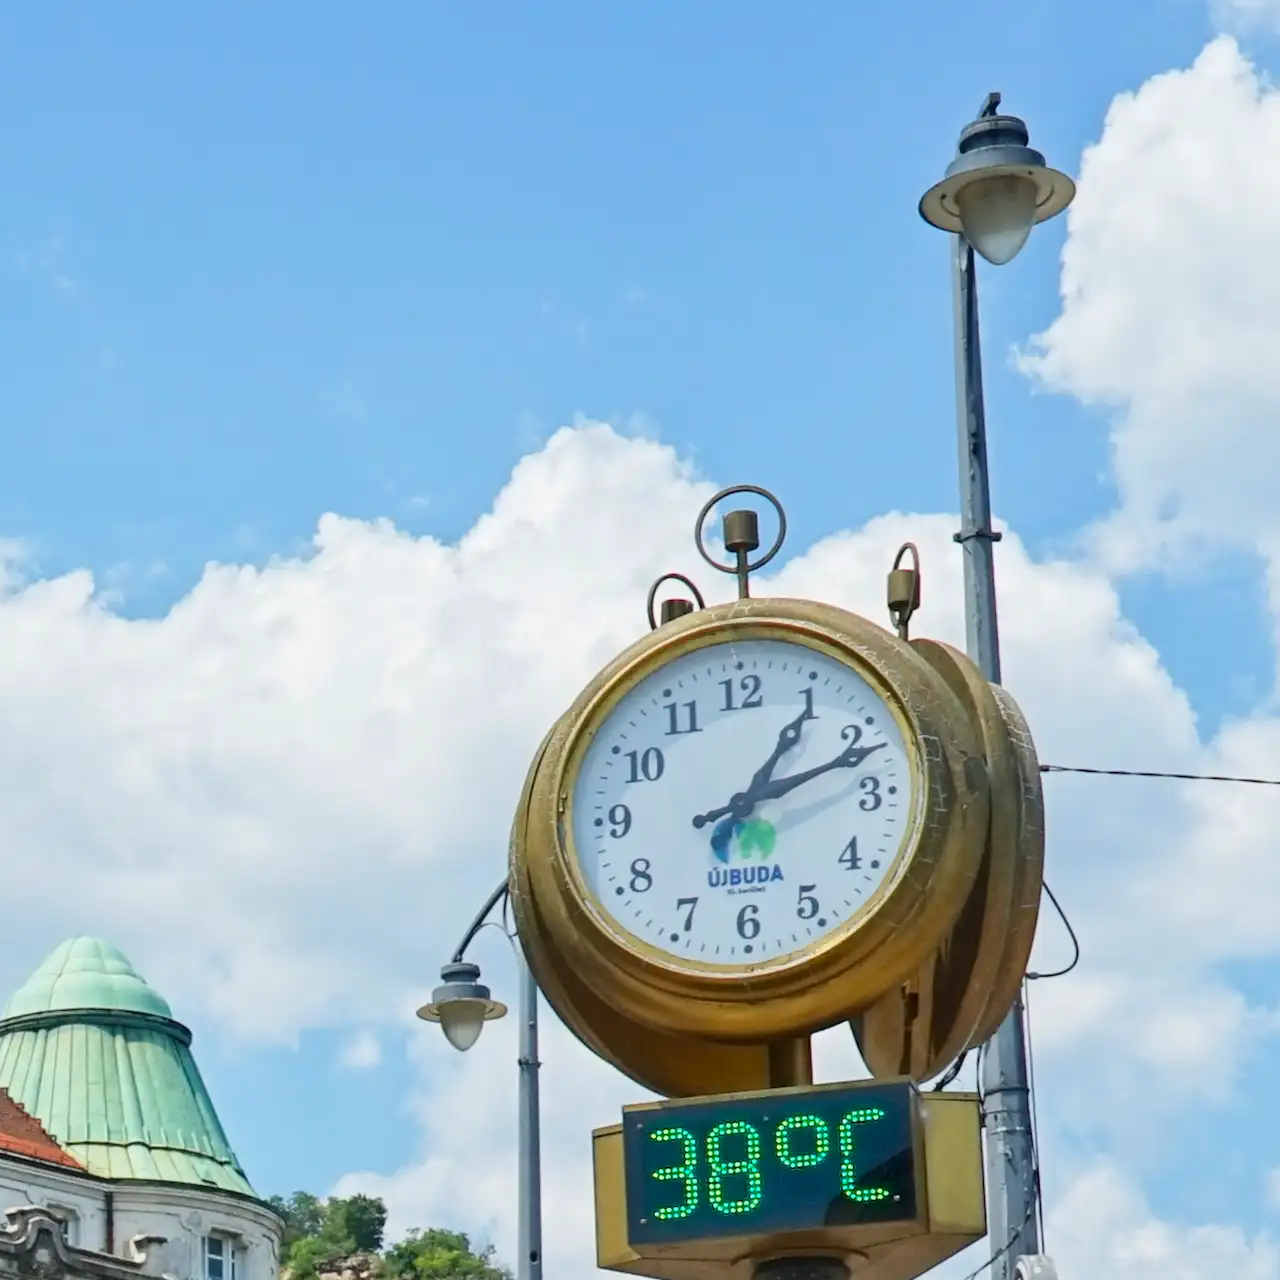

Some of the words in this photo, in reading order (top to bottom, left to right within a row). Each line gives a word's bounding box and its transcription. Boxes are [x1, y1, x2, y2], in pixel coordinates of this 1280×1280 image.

[718, 674, 764, 713] 12
[798, 686, 821, 720] 1
[663, 700, 704, 736] 11
[840, 724, 864, 757] 2
[623, 746, 666, 784] 10
[858, 776, 883, 812] 3
[608, 804, 632, 838] 9
[837, 835, 863, 871] 4
[629, 858, 653, 893] 8
[707, 863, 785, 888] ÚJBUDA
[676, 896, 699, 932] 7
[796, 883, 821, 919] 5
[736, 904, 761, 940] 6
